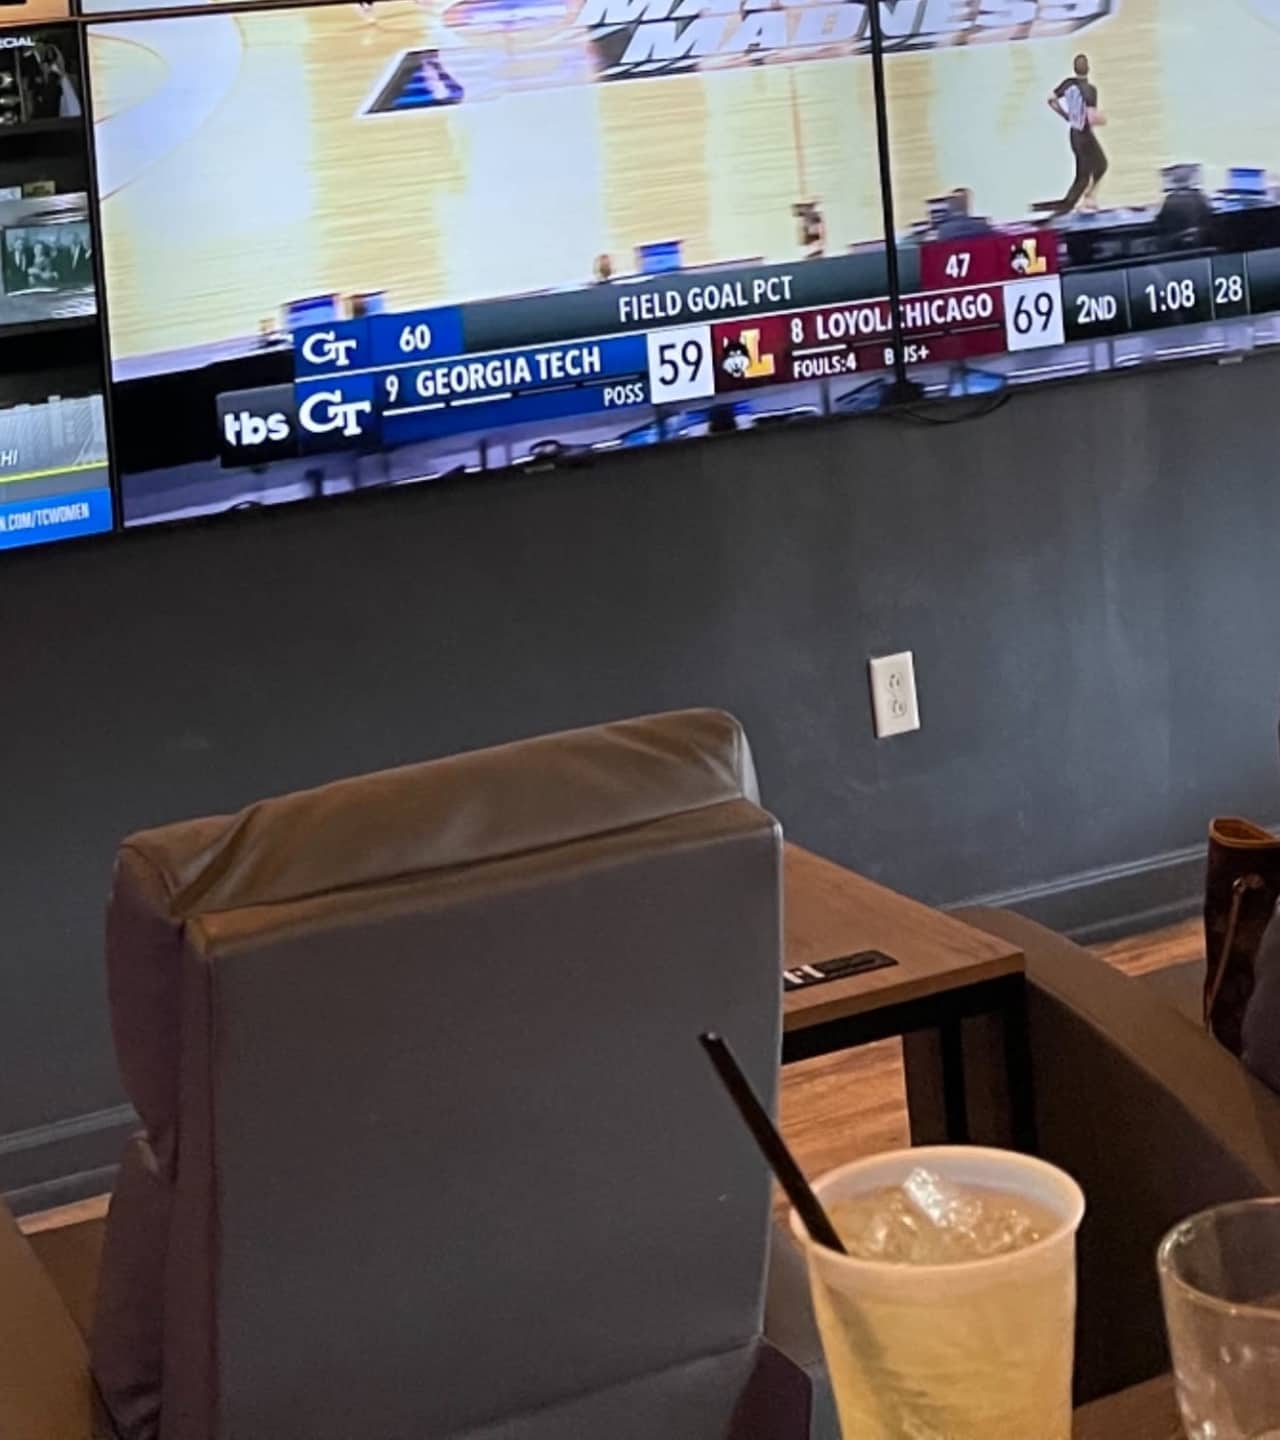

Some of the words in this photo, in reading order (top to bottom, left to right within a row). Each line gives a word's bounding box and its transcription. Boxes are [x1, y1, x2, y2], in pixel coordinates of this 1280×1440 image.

[223, 410, 291, 446] tbs
[298, 389, 372, 437] GT
[384, 375, 400, 402] 9
[415, 357, 531, 398] GEORGIA
[534, 346, 602, 381] TECH
[658, 340, 704, 386] 59
[790, 318, 804, 344] 8
[899, 292, 994, 329] HICAGO
[1012, 291, 1054, 334] 69
[1076, 295, 1117, 324] 2ND
[1145, 279, 1196, 313] 1:08
[1213, 275, 1243, 304] 28
[301, 330, 357, 366] GT
[398, 324, 432, 353] 60
[618, 291, 682, 322] FIELD
[687, 282, 748, 312] GOAL
[753, 275, 794, 304] PCT
[944, 252, 970, 279] 47
[602, 382, 645, 407] POSS
[792, 353, 857, 379] FOULS:4
